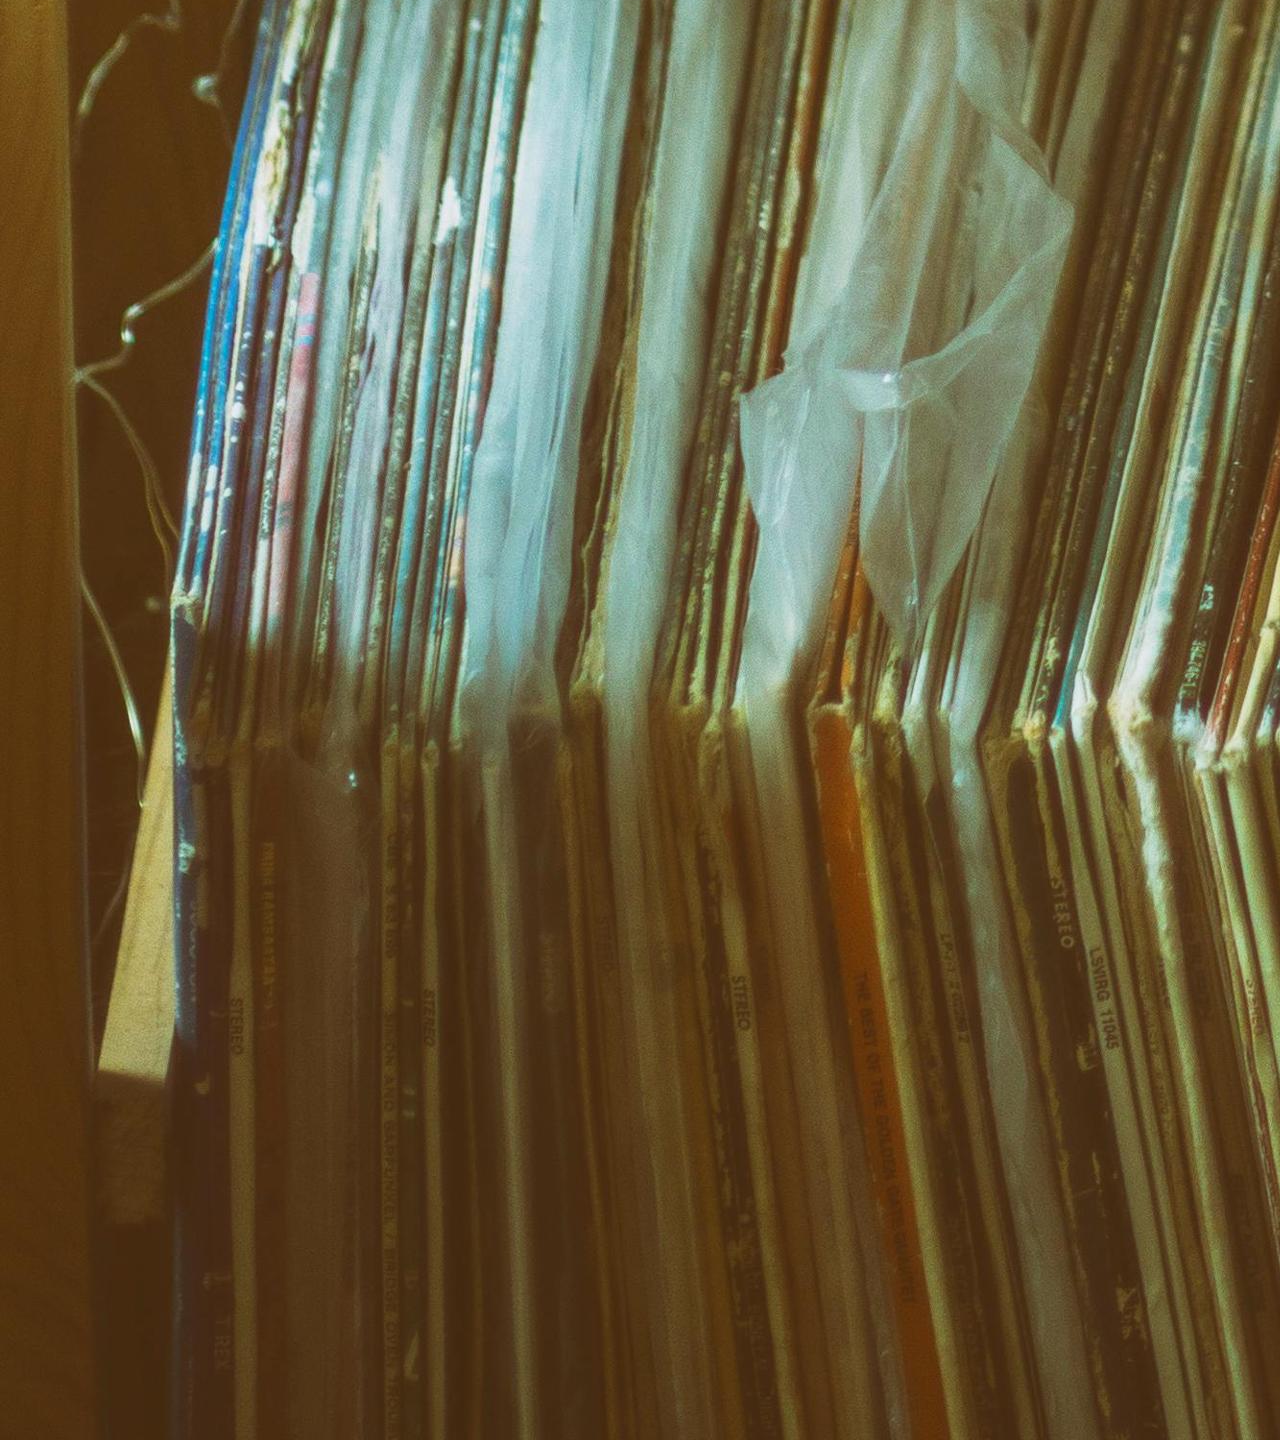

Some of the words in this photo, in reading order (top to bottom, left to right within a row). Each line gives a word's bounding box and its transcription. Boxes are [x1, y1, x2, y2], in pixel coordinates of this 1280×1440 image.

[1050, 877, 1075, 950] STEREO
[731, 975, 752, 1032] STEREO
[1089, 946, 1112, 1005] LSVIRG
[1099, 1007, 1121, 1051] 11045
